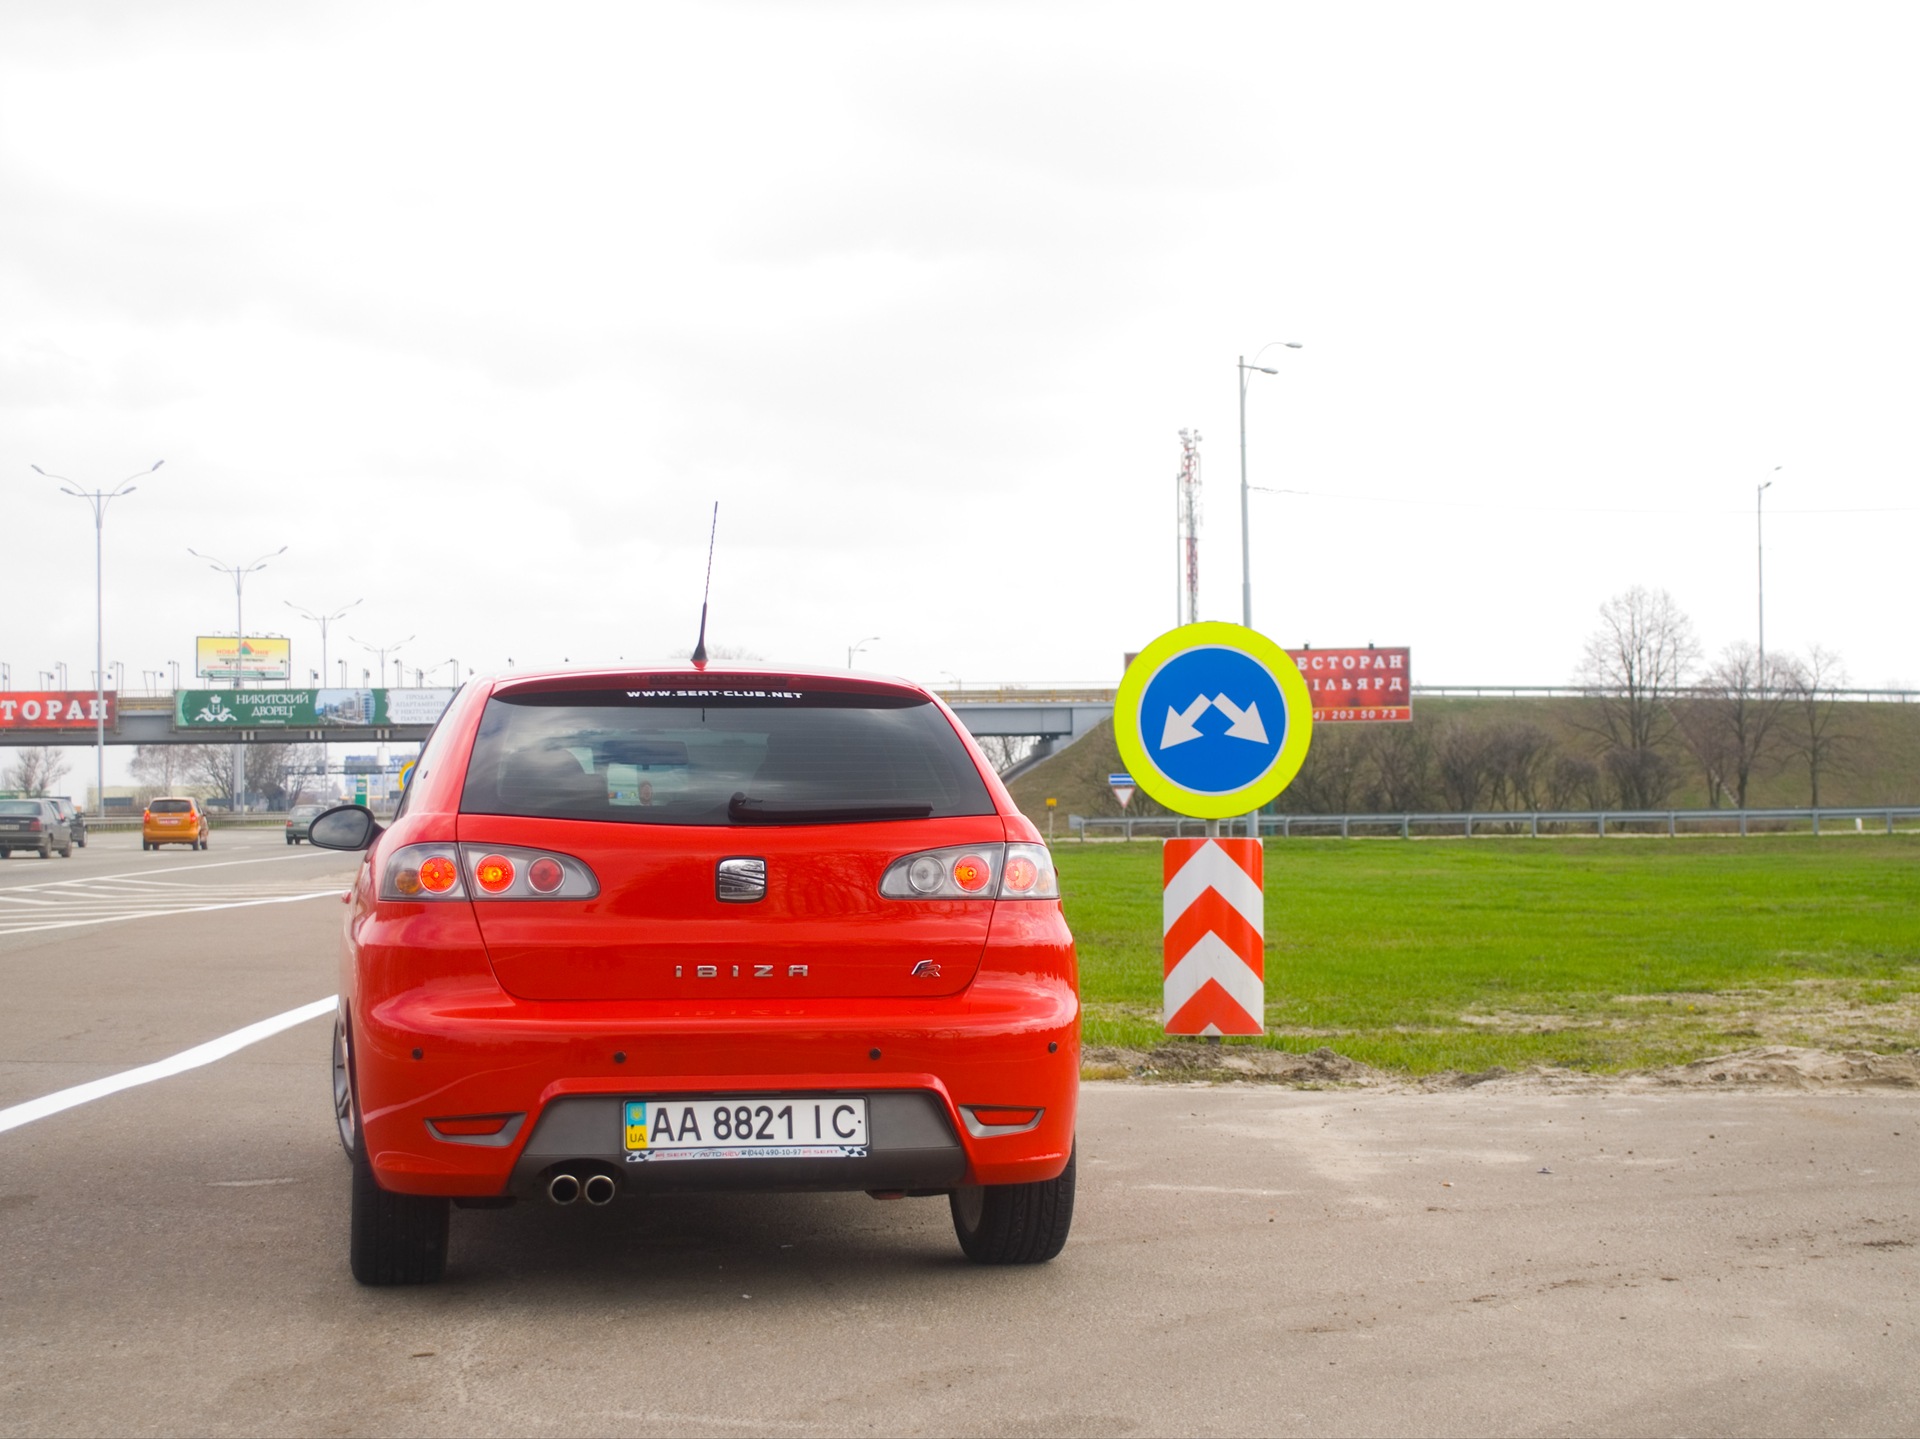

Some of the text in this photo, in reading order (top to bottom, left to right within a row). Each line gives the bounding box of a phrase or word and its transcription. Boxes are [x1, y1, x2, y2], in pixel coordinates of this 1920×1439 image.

[1296, 655, 1402, 670] ЕСТОРАН
[1304, 677, 1402, 691] ІЛЬЯРД
[236, 692, 309, 705] НИКИТСКИЙ
[626, 690, 803, 699] WWW.SEAT-CLUB.NET
[0, 700, 108, 720] ТОРАН
[251, 706, 294, 718] ДВОРЕЦ
[1332, 711, 1354, 719] 203
[1361, 711, 1376, 719] 50
[1382, 710, 1397, 718] 73
[675, 965, 808, 978] IBIZA
[911, 959, 941, 978] FR
[630, 1133, 645, 1143] UA
[650, 1107, 702, 1142] AA
[713, 1105, 794, 1140] 8821
[766, 1148, 801, 1156] 490-10-97
